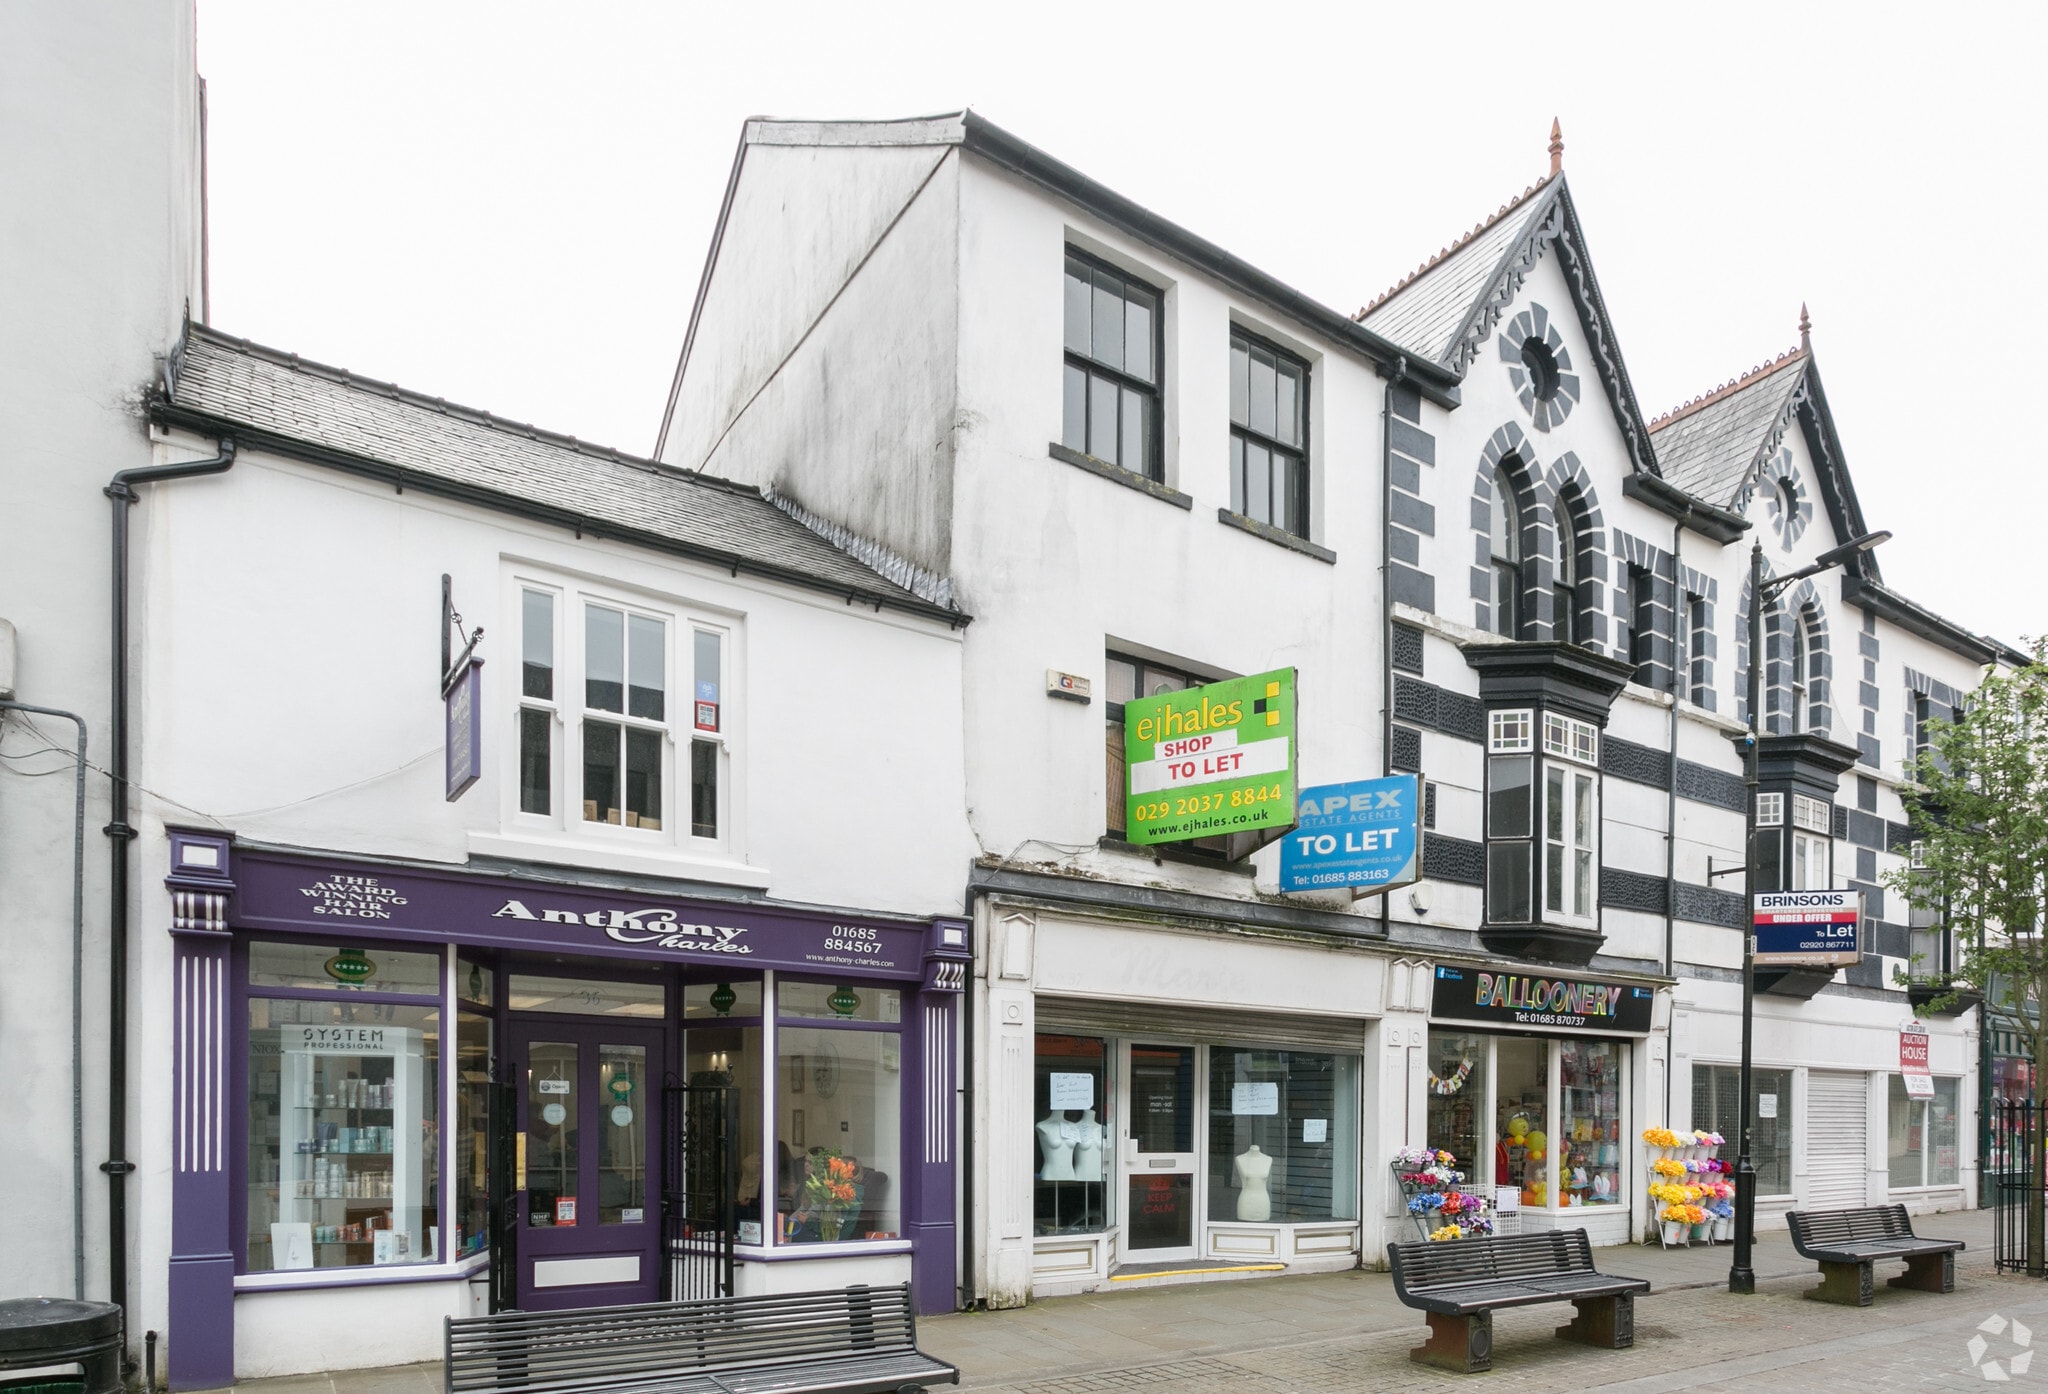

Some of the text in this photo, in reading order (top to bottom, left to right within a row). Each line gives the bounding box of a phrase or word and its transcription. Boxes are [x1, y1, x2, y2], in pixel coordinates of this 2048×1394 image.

[1137, 696, 1243, 746] ejhales
[1164, 736, 1213, 757] SHOP
[1168, 753, 1244, 780] TO LET
[1135, 784, 1282, 822] 029 2037 8844
[1299, 789, 1402, 818] APEX
[1148, 809, 1269, 836] www.ejhales.co.uk
[1299, 809, 1401, 827] ESTATE AGENTS
[1297, 828, 1399, 856] TO LET
[1292, 854, 1403, 870] www.apexestateagents.co.uk
[330, 875, 379, 887] THE
[1294, 868, 1389, 885] Tel: 01685 883163
[299, 888, 408, 905] WINNING
[313, 882, 397, 896] AWARD
[324, 899, 384, 911] HAIR
[1761, 895, 1844, 907] BRINSONS
[313, 906, 391, 919] SALON
[1773, 913, 1832, 923] UNDER OFFER
[491, 900, 748, 942] Anthony
[832, 925, 877, 940] 01685
[1827, 924, 1854, 937] Let
[824, 938, 882, 954] 884567
[1800, 941, 1854, 949] 02920 867711
[1476, 973, 1622, 1016] BALLOONERY
[1515, 1011, 1586, 1026] Tel: 01685 870737
[303, 1028, 384, 1042] SYSTEM
[1903, 1034, 1927, 1045] AUCTION
[252, 1044, 281, 1055] NIOX
[303, 1042, 384, 1050] PROFESSIONAL
[1902, 1046, 1927, 1060] HOUSE
[1147, 1192, 1172, 1202] KEEP
[1142, 1203, 1175, 1214] CALM
